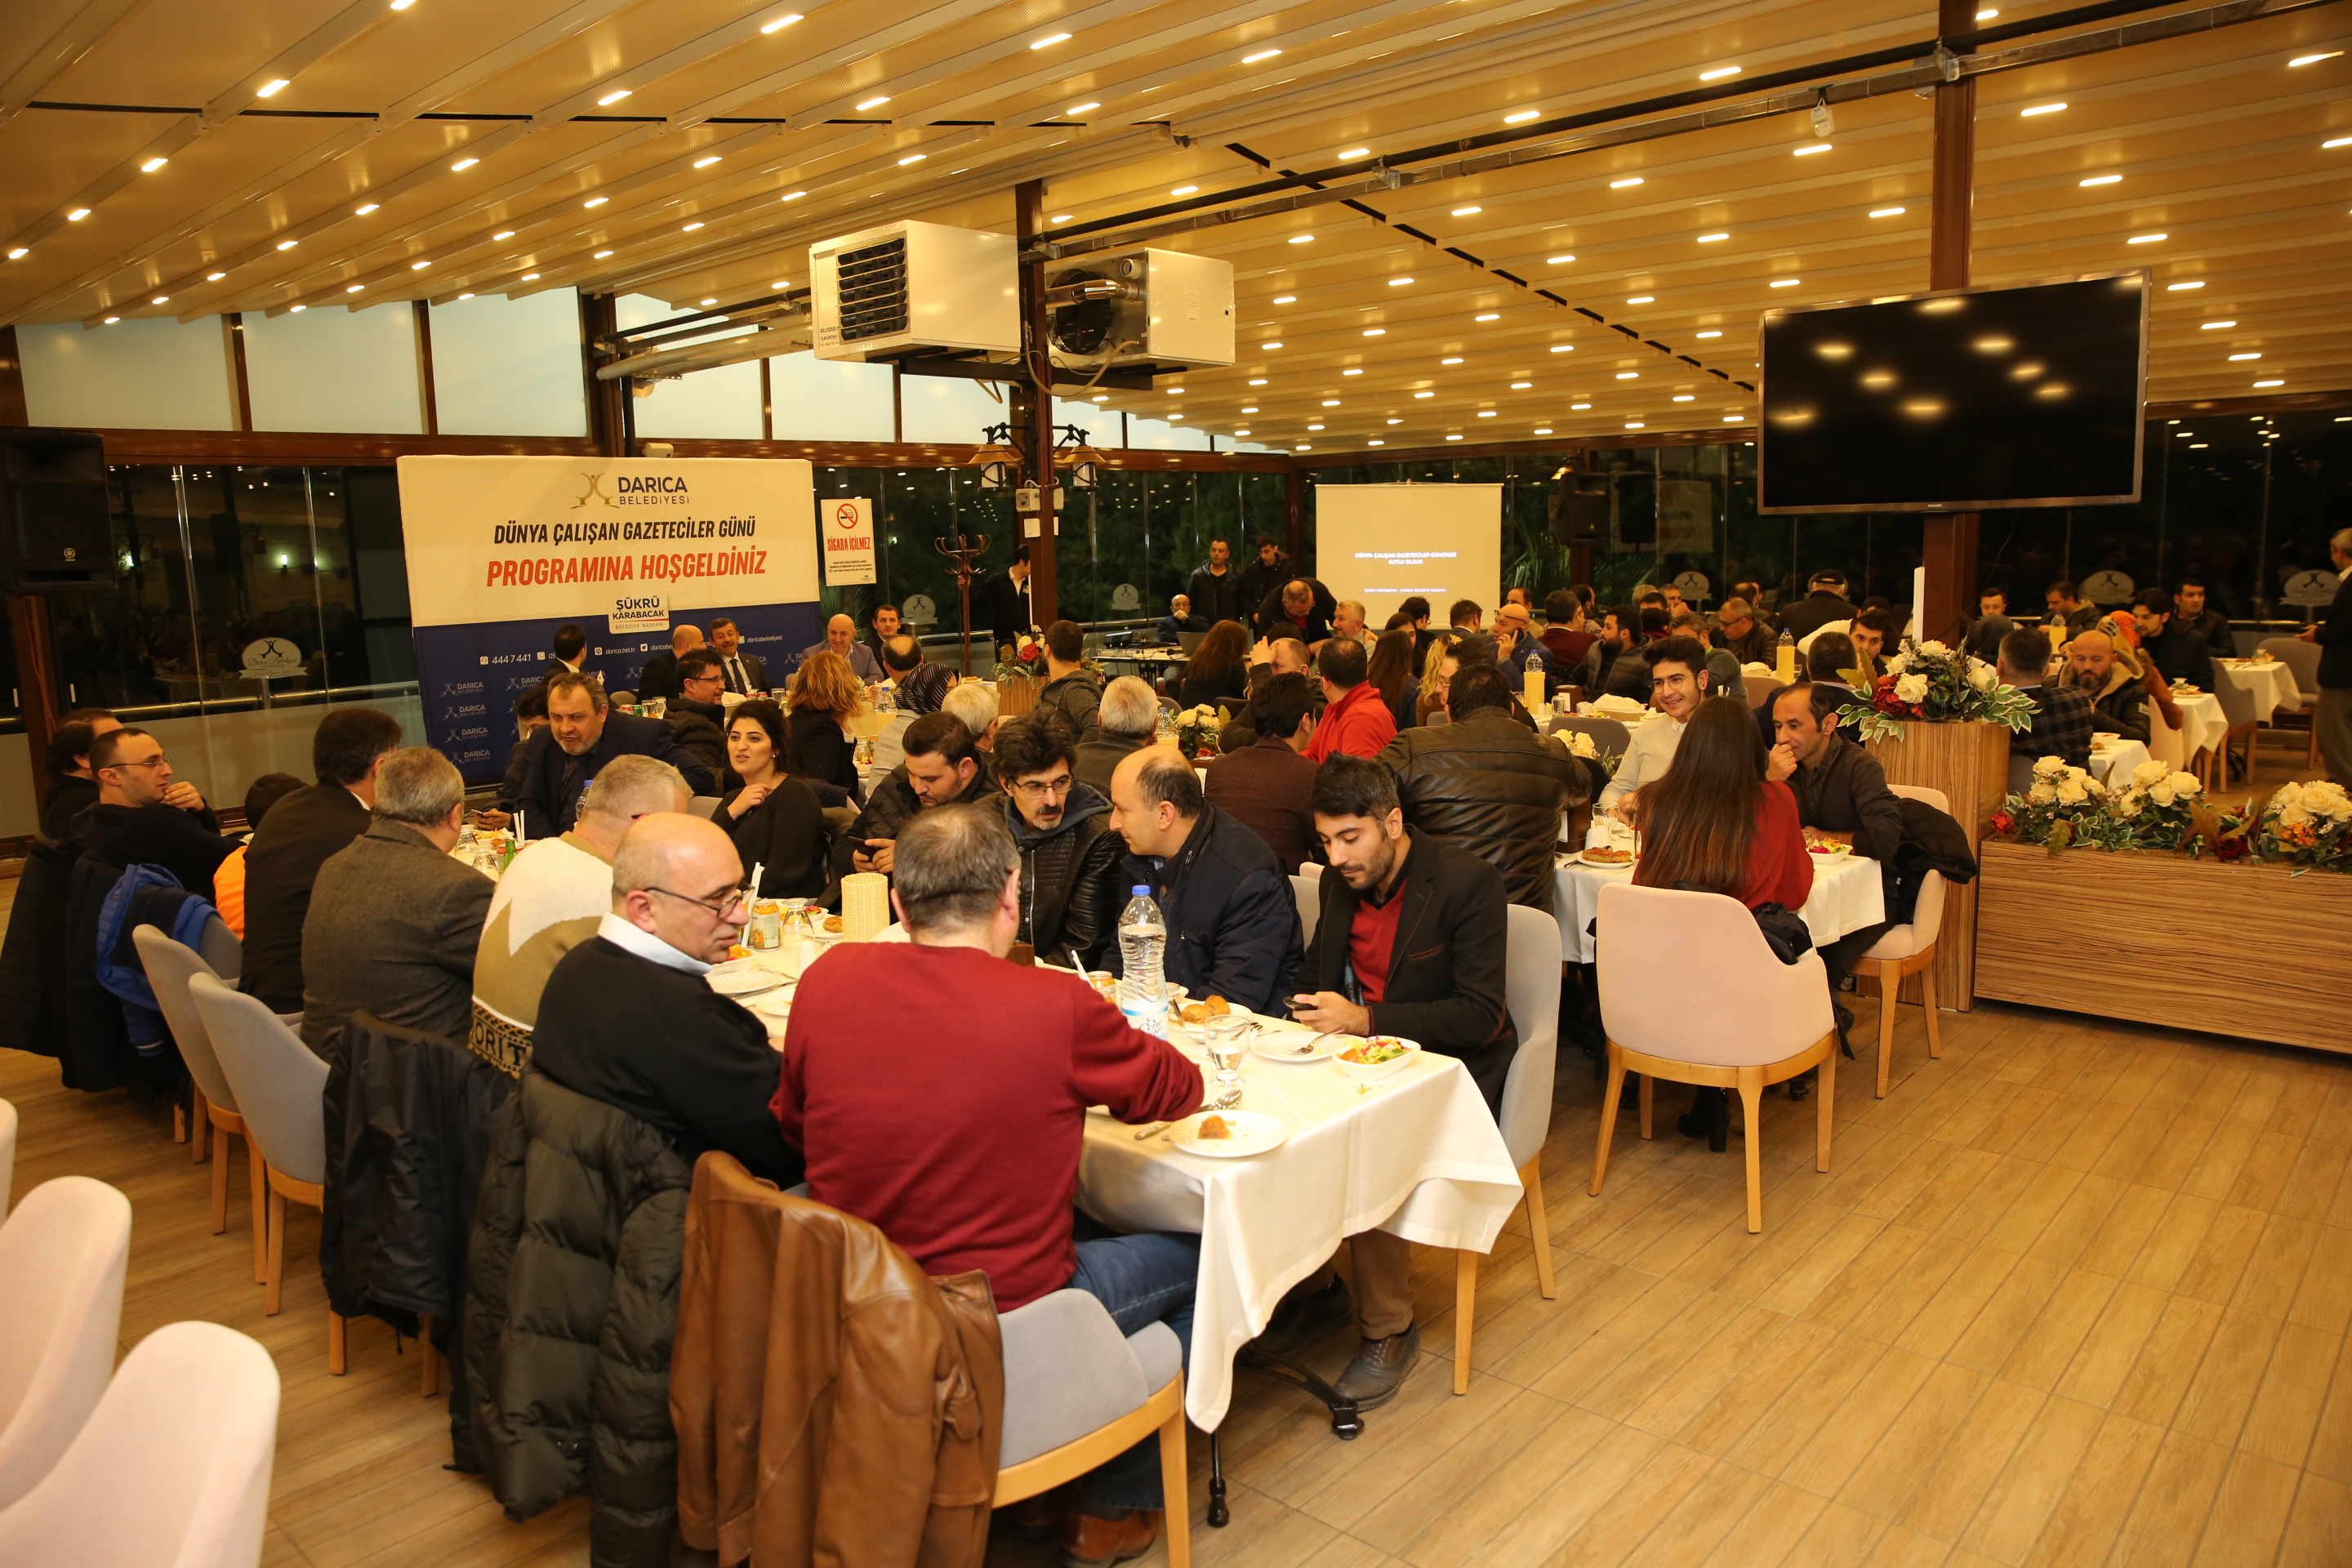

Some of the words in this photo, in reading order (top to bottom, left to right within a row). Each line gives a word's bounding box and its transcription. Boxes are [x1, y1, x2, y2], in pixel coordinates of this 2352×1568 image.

[617, 476, 688, 493] DARICA
[493, 520, 548, 544] DÜNYA
[553, 523, 620, 546] ÇALIŞAN
[622, 516, 715, 540] GAZETECİLER
[718, 515, 756, 537] GÜNÜ
[827, 537, 849, 551] SİGARA
[849, 535, 871, 552] İÇİLMEZ
[487, 555, 634, 587] PROGRAMINA
[639, 545, 768, 583] HOŞGELDİNİZ
[616, 595, 660, 612] ŞÜKRÜ
[612, 610, 665, 620] KARABACAK
[605, 646, 636, 655] darica.bel.tr
[492, 655, 509, 665] 444
[457, 681, 484, 690] DARICA
[459, 704, 487, 713] DARICA
[461, 727, 488, 736] DARICA
[464, 749, 490, 759] DARICA
[472, 1021, 528, 1067] ORIT
